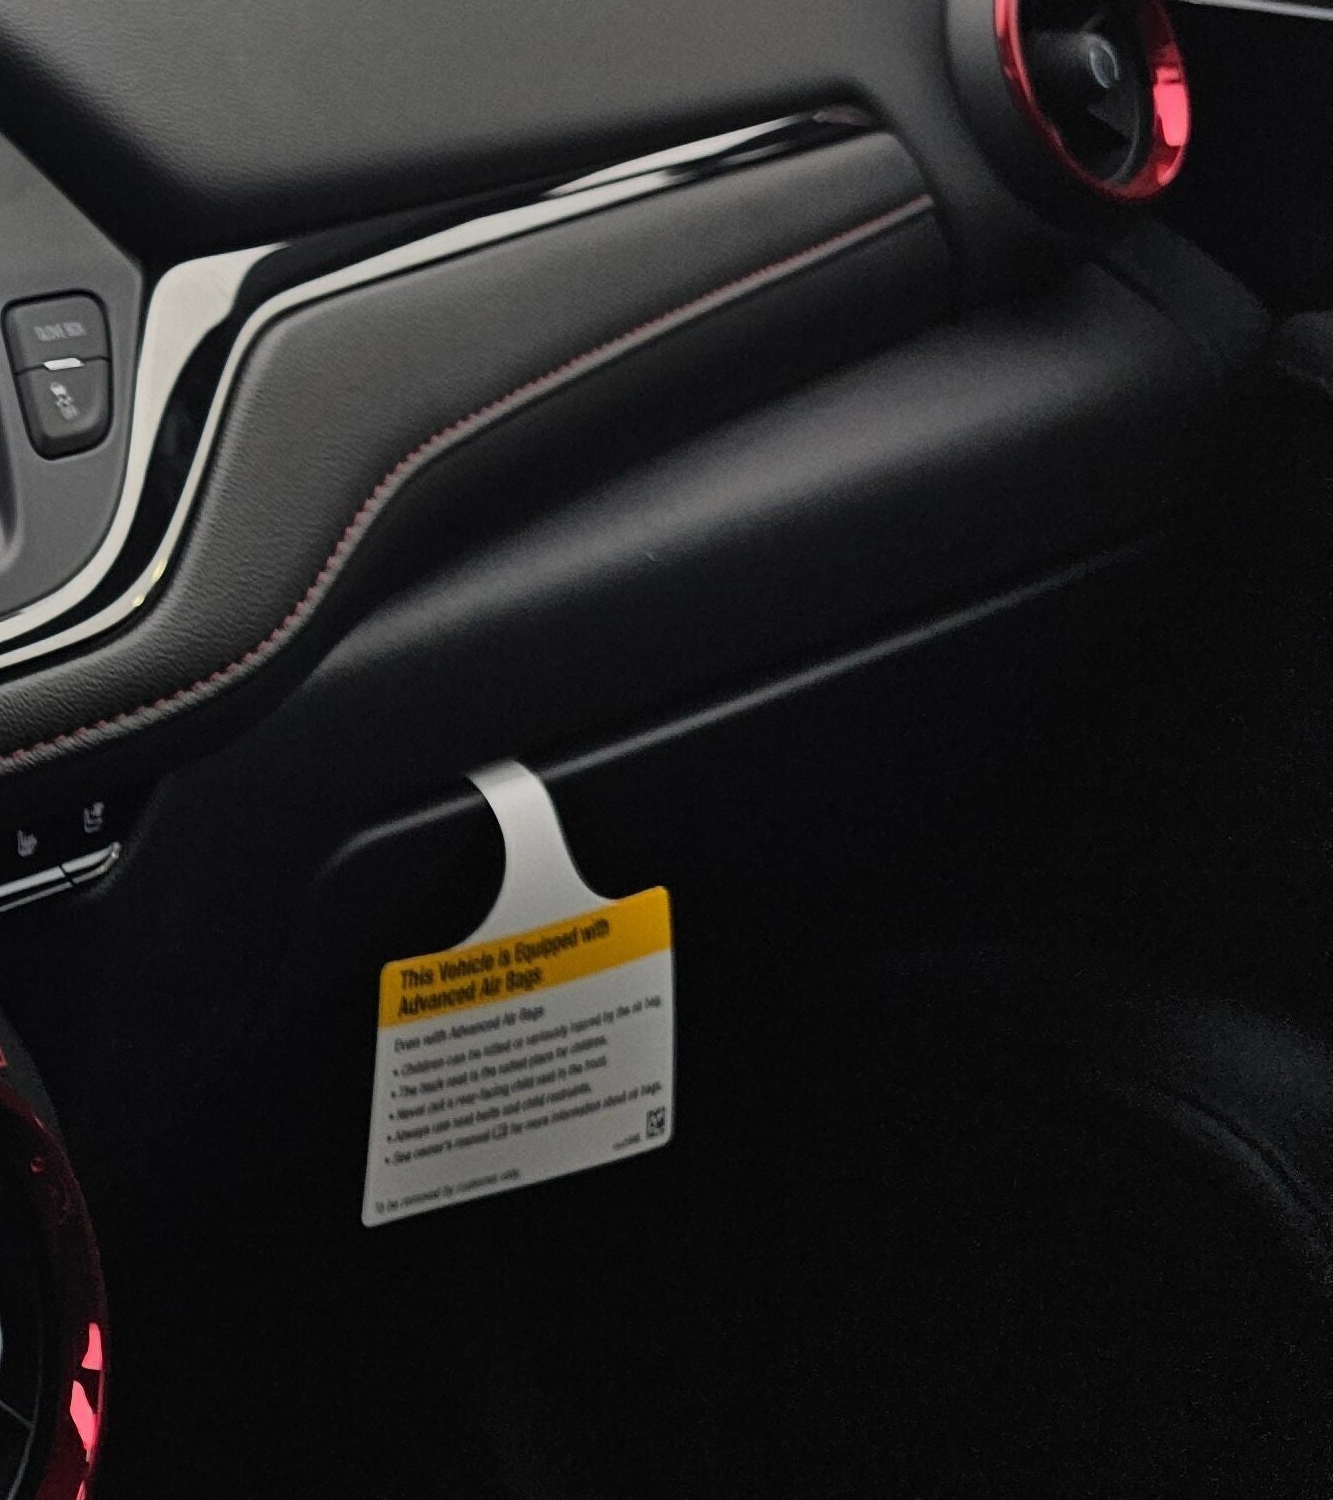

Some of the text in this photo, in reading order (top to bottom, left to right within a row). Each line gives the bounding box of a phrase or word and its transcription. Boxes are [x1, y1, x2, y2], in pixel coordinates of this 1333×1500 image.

[399, 917, 611, 991] This Vehicle is Equipped with
[398, 968, 543, 1018] Advanced Air Bags
